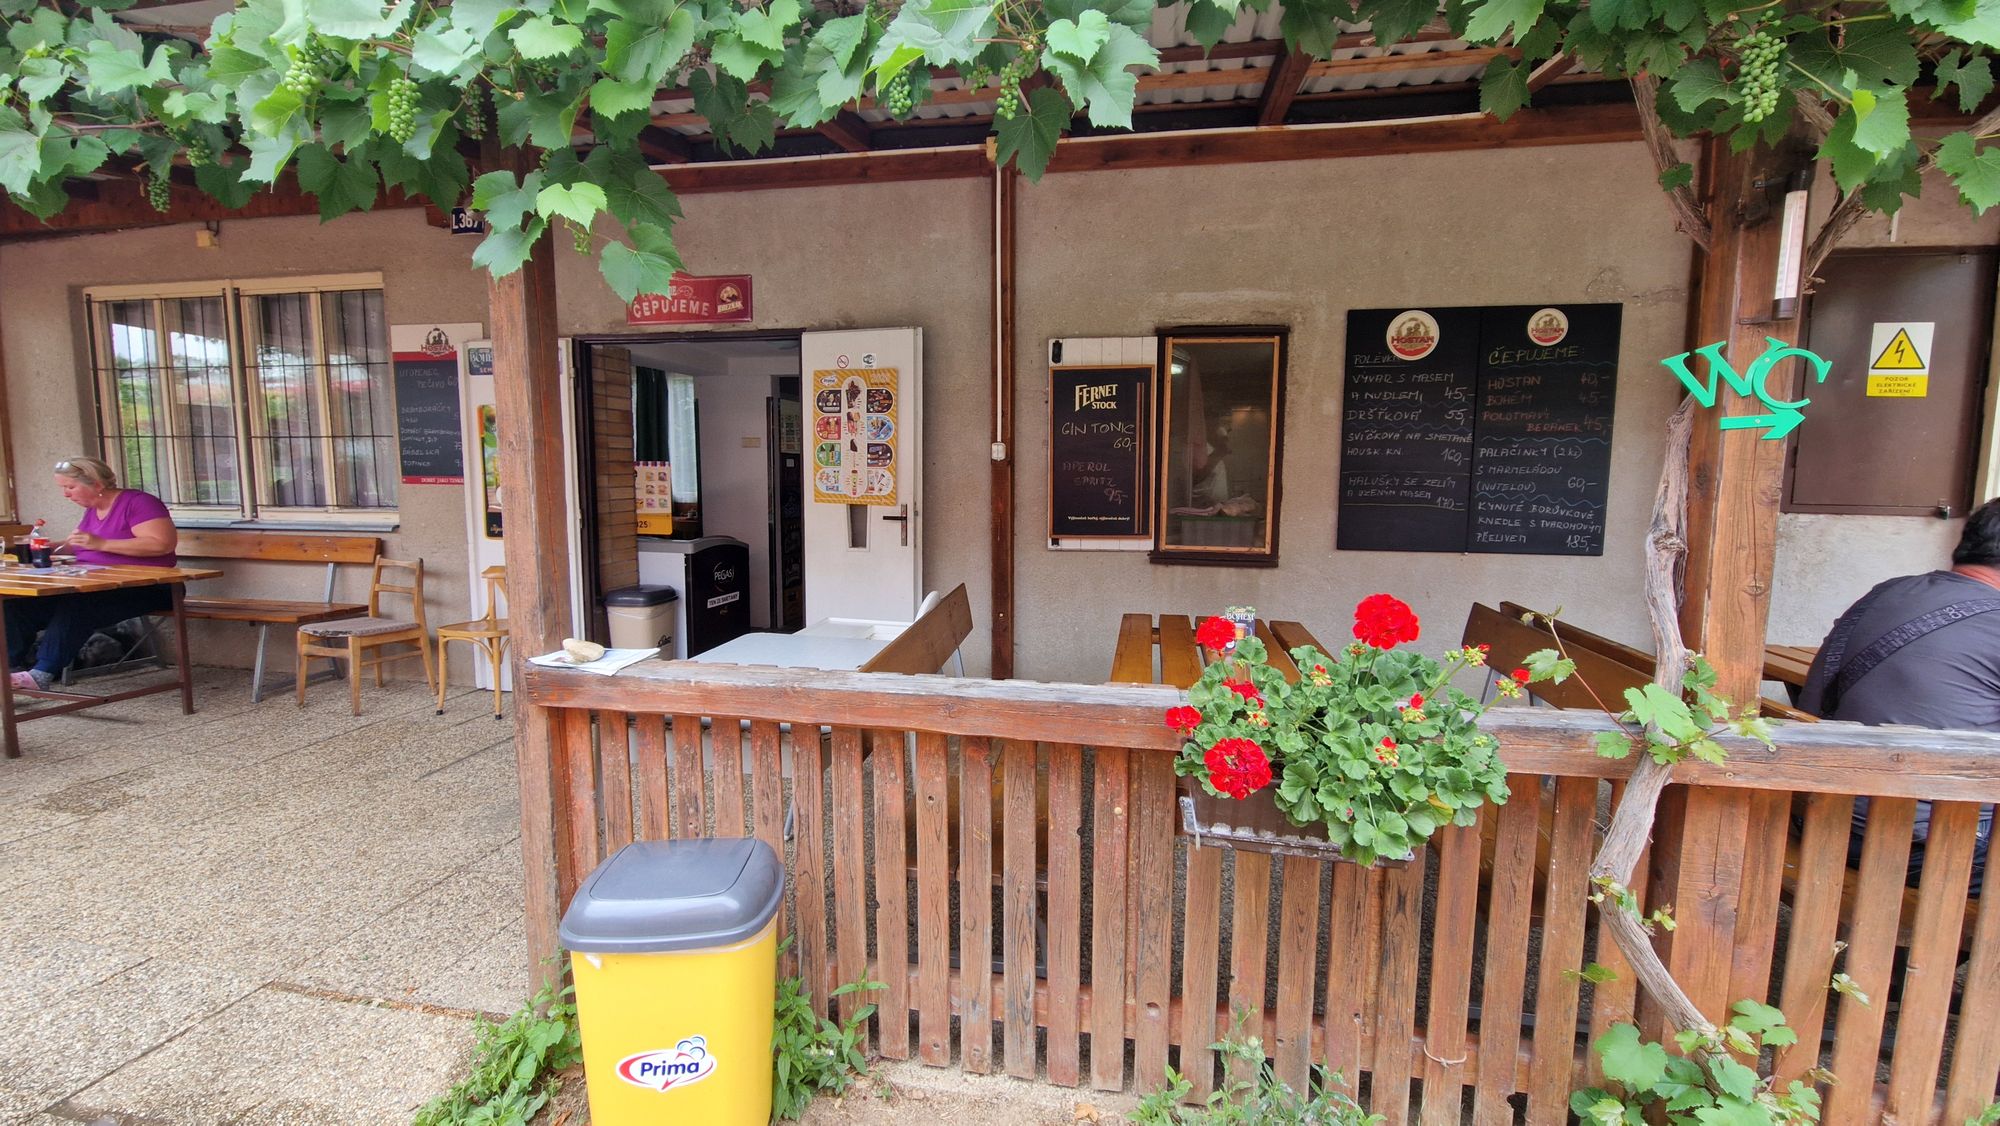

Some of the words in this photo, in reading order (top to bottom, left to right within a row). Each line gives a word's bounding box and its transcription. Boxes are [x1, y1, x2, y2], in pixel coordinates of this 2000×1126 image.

[633, 299, 709, 318] ČEPUJEME
[1391, 336, 1435, 344] HOSTAN
[1661, 336, 1832, 408] WC
[1397, 373, 1406, 383] S
[1412, 373, 1454, 383] MASEM
[1488, 376, 1541, 390] HOSTAN
[1075, 384, 1118, 411] FERNET
[1351, 392, 1359, 400] A
[1092, 401, 1117, 410] STOCK
[1062, 422, 1087, 435] GIN
[1091, 421, 1135, 434] TONIC
[1480, 444, 1547, 457] PALAČINKY
[1475, 465, 1483, 475] S
[1488, 464, 1562, 474] MARMELÁDOU
[1403, 477, 1417, 486] SE
[1568, 476, 1598, 492] 60,-
[1400, 490, 1432, 499] MASEM
[1478, 501, 1524, 512] KYNUTÉ
[1478, 517, 1521, 527] KNEDLE
[1529, 519, 1536, 528] S
[1566, 535, 1599, 552] 185,-
[714, 569, 732, 580] PEGAS
[640, 1060, 699, 1076] Prima
